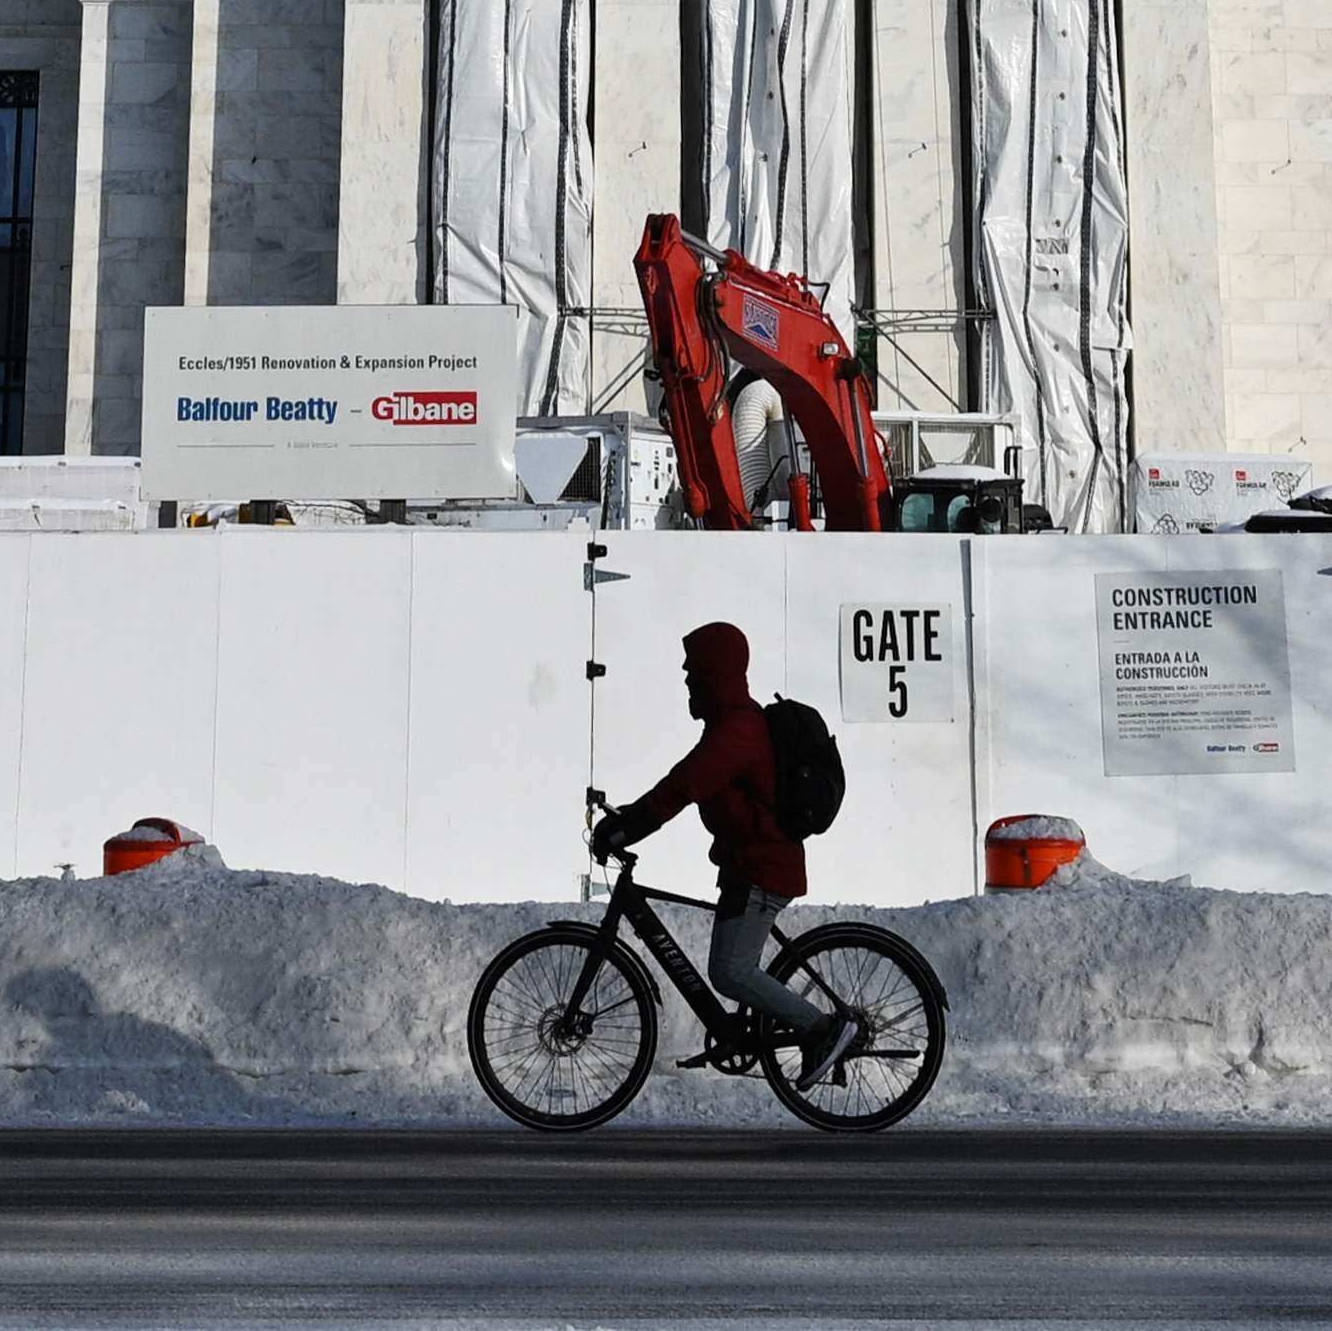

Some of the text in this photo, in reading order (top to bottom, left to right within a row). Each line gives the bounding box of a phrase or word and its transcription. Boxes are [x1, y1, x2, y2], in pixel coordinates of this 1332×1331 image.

[179, 354, 478, 372] Eccles/1951 Renovation & Expansion Project
[177, 395, 476, 424] Balfour Beatty Gilbane
[1112, 585, 1258, 607] CONSTRUCTION
[1113, 609, 1213, 631] ENTRANCE
[852, 609, 943, 662] GATE
[1115, 651, 1200, 665] ENTRADA A LA
[1116, 665, 1209, 680] CONSTRUCCIÓN
[888, 665, 909, 719] 5
